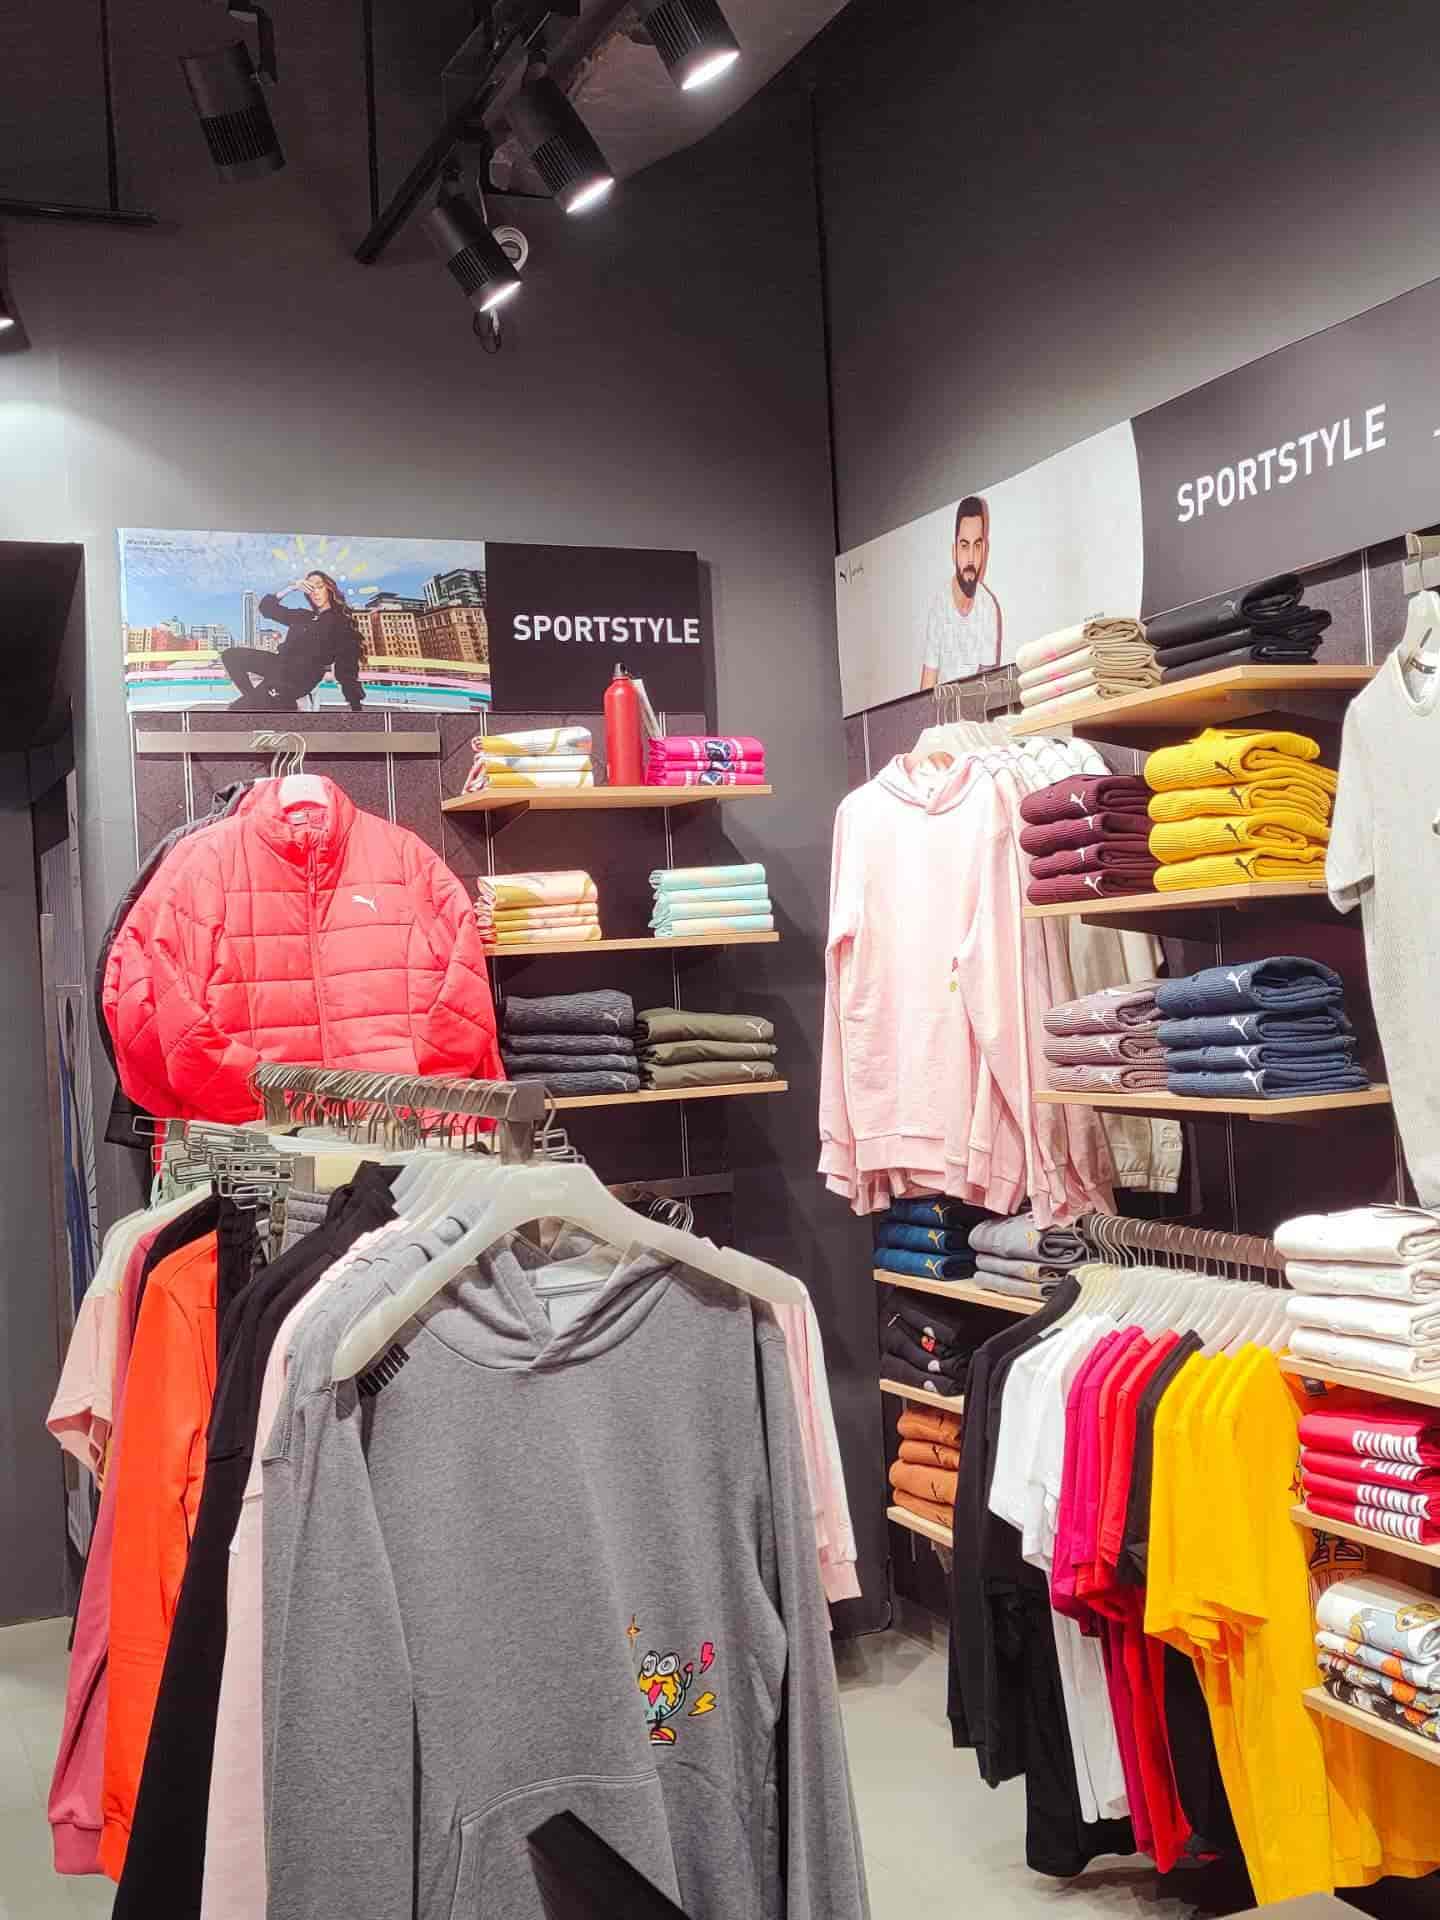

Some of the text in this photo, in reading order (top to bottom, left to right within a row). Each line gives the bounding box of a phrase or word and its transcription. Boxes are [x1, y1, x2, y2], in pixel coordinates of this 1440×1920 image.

[1177, 403, 1387, 523] SPORTSTYLE
[513, 614, 700, 644] SPORTSTYLE
[357, 1343, 410, 1397] UMA
